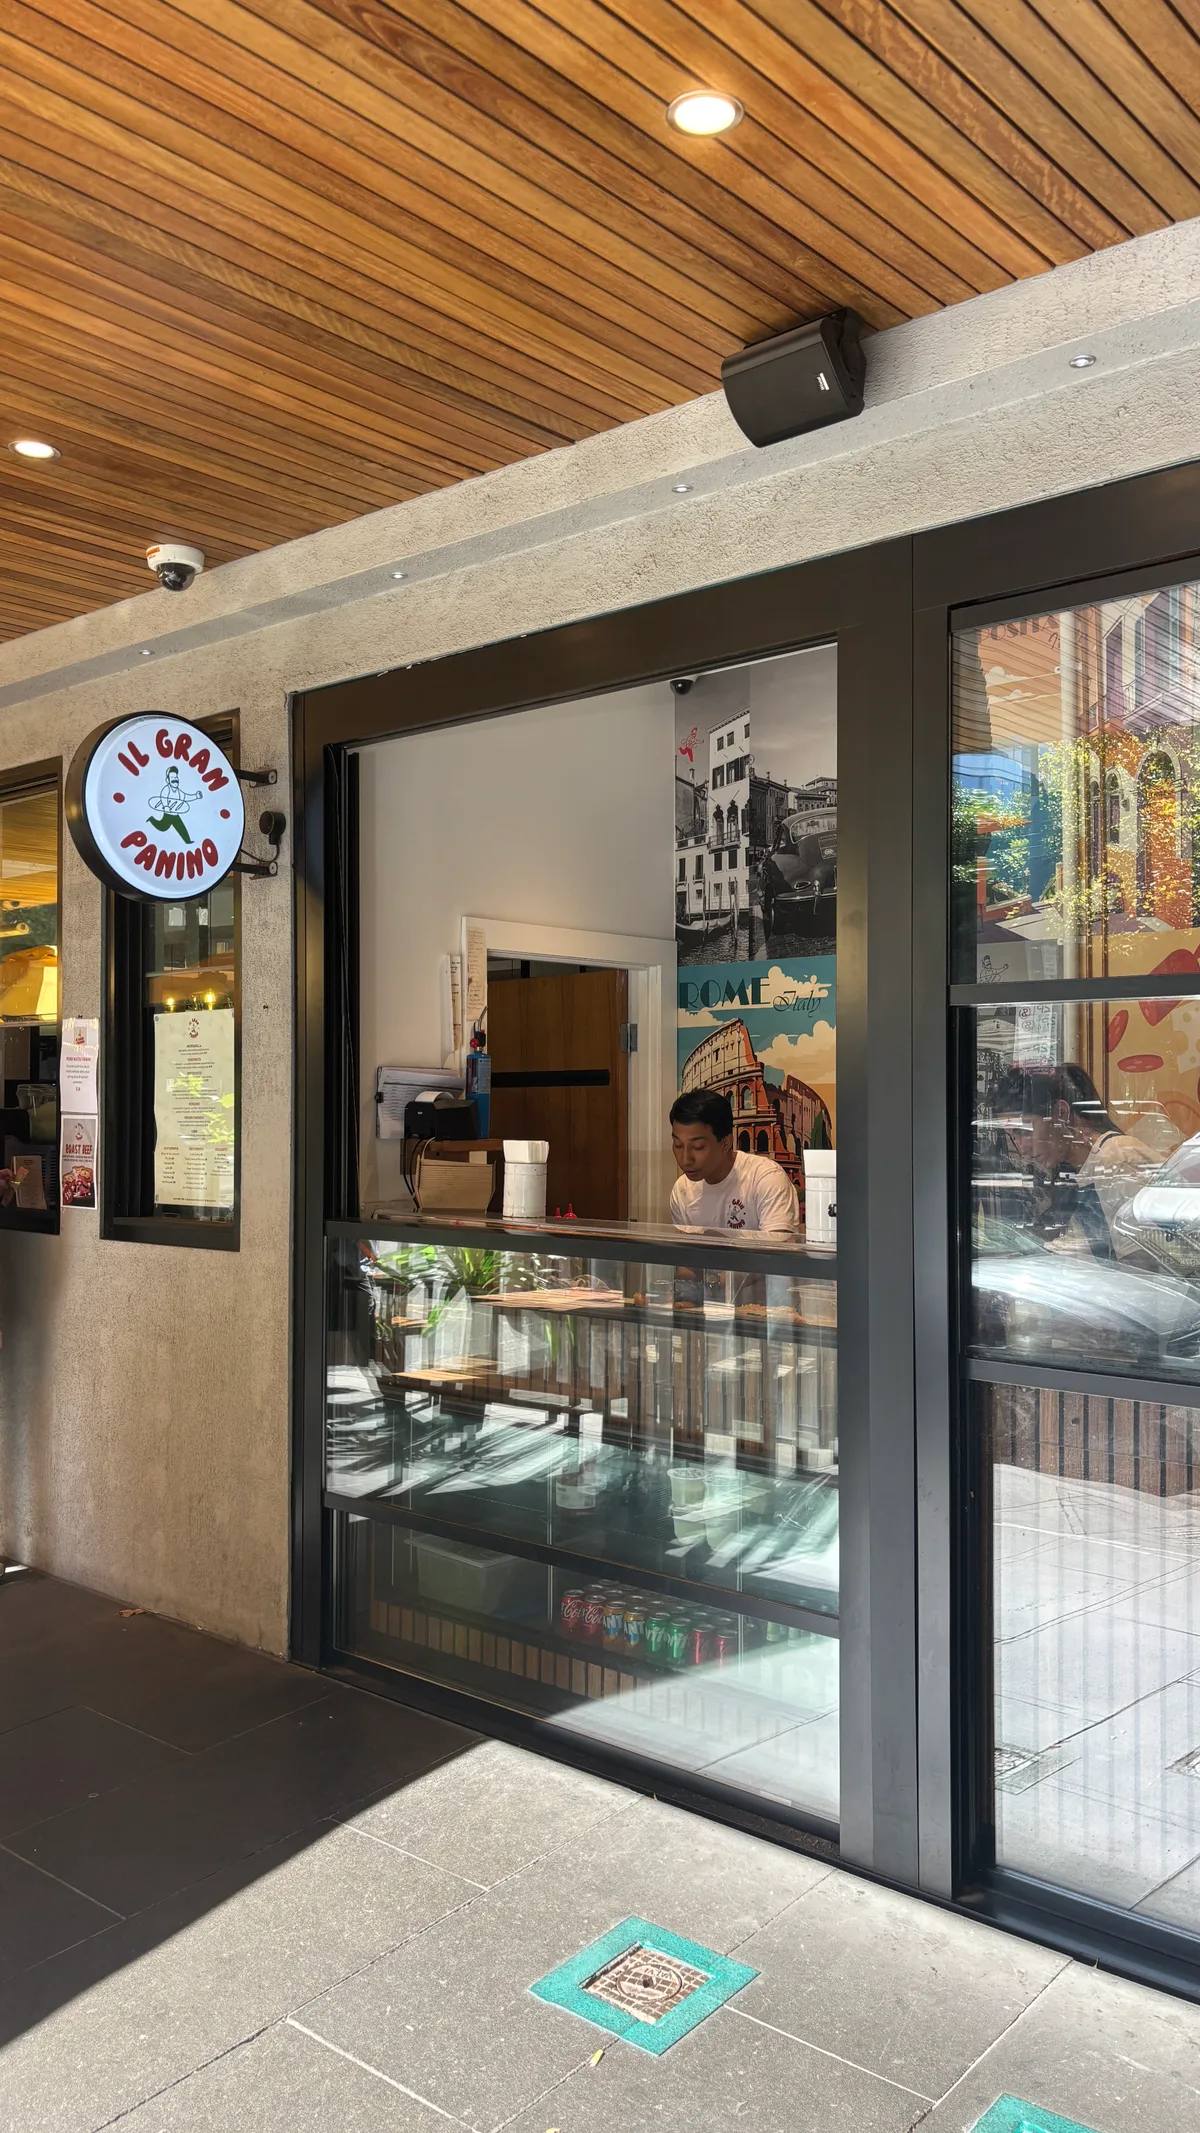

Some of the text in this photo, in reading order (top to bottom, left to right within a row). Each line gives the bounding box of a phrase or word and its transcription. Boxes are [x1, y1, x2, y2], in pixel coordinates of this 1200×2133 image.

[117, 728, 229, 792] IL GRAN
[120, 830, 219, 881] PANINO
[679, 976, 821, 1018] ROME Italy
[65, 1143, 93, 1155] ROAST BEEF
